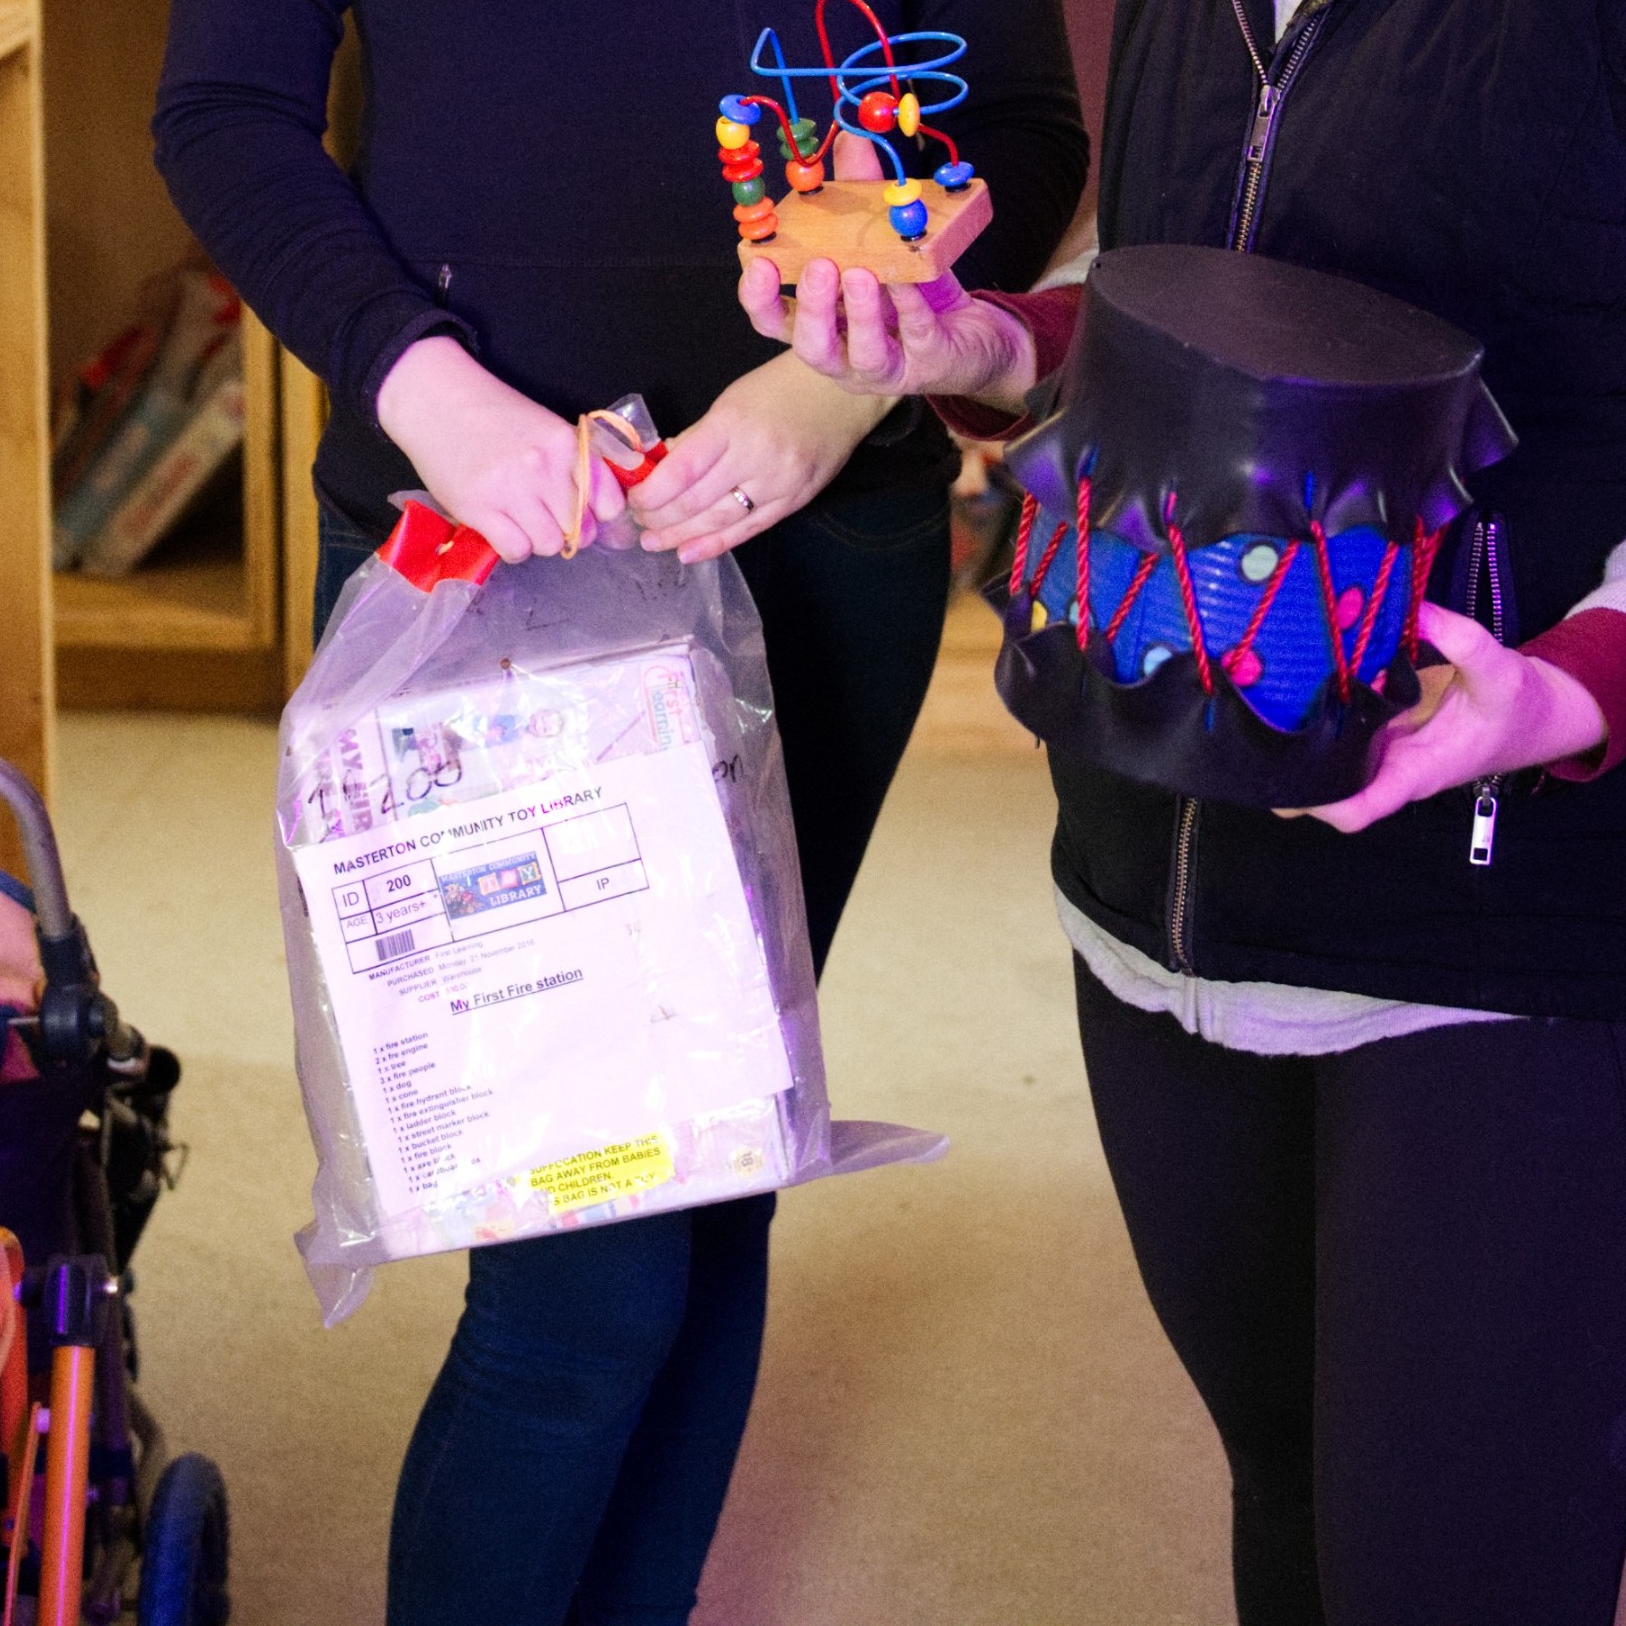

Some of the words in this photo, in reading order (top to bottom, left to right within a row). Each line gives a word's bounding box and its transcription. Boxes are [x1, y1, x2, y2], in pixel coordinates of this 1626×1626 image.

[333, 838, 417, 876] MASTERTON
[507, 805, 537, 823] TOY
[539, 786, 603, 816] LIBRARY
[487, 852, 537, 871] COMMUNITY
[478, 862, 542, 895] TOY
[596, 876, 610, 891] IP
[341, 891, 360, 908] ID
[386, 874, 412, 893] 200
[489, 883, 542, 906] LIBRARY
[346, 915, 369, 929] AGE
[375, 911, 384, 924] 3
[386, 900, 427, 923] years+
[369, 955, 431, 981] MANUFACTURER
[451, 940, 484, 956] Learning
[387, 966, 435, 988] PURCHASED
[481, 945, 516, 961] November
[399, 978, 439, 997] SUPPLIER
[441, 966, 483, 984] Warehouse
[450, 998, 470, 1014] My
[473, 988, 505, 1006] First
[507, 980, 534, 999] Fire
[536, 967, 584, 989] station
[418, 990, 441, 1004] COST
[385, 1040, 399, 1050] fire
[400, 1032, 429, 1046] station
[400, 1042, 429, 1056] engine
[390, 1060, 406, 1070] tree
[393, 1071, 407, 1080] fire
[408, 1061, 436, 1077] people
[396, 1080, 412, 1091] dog
[399, 1088, 419, 1100] cone
[401, 1101, 415, 1110] fire
[416, 1090, 448, 1106] hydrant
[403, 1111, 417, 1120] fire
[419, 1095, 470, 1115] extinguisher
[471, 1088, 494, 1100] block
[406, 1117, 432, 1130] ladder
[434, 1109, 457, 1121] block
[411, 1126, 435, 1139] street
[436, 1118, 465, 1131] marker
[466, 1111, 490, 1123] block
[411, 1136, 440, 1150] bucket
[440, 1129, 463, 1141] block
[603, 1142, 633, 1156] KEEP
[414, 1150, 428, 1160] fire
[429, 1143, 452, 1155] block
[417, 1161, 432, 1170] axe
[530, 1173, 555, 1189] BAG
[556, 1166, 587, 1182] AWAY
[588, 1158, 621, 1173] FROM
[621, 1146, 662, 1165] BABIES
[558, 1171, 615, 1192] CHILDREN.
[562, 1190, 586, 1204] BAG
[587, 1186, 599, 1198] IS
